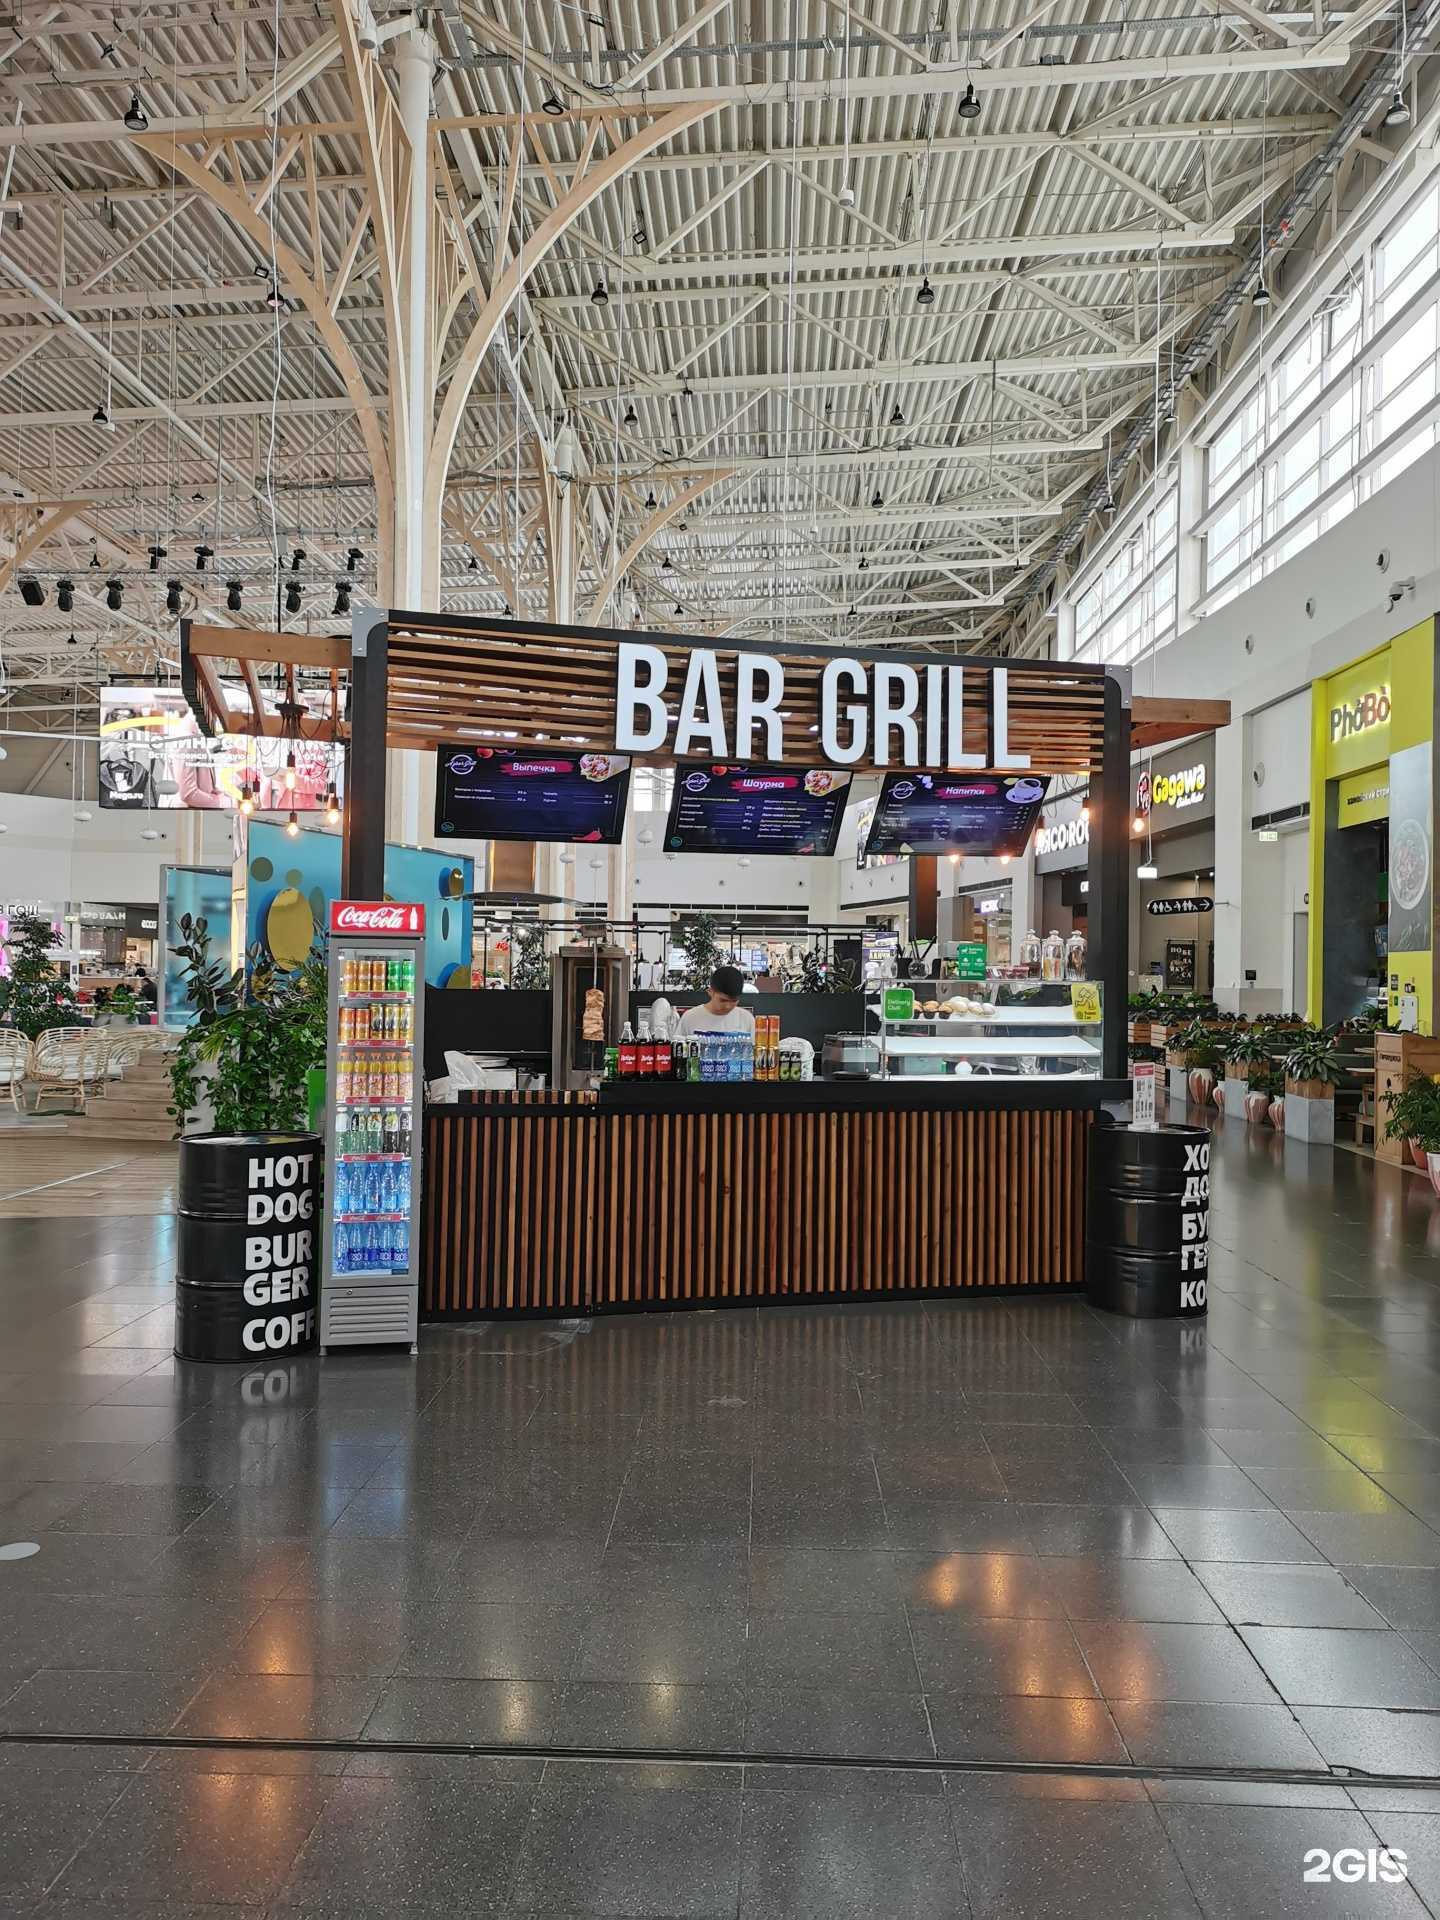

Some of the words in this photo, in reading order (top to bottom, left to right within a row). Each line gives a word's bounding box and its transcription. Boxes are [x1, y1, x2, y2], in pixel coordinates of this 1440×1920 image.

[615, 642, 785, 761] BAR
[822, 657, 1032, 769] GRILL
[512, 762, 556, 773] Выпечка
[743, 779, 785, 789] Шаурма
[945, 786, 985, 795] Напитки
[1153, 763, 1206, 806] Gagawa
[337, 906, 408, 929] Coca-Cola
[248, 1154, 314, 1189] HOT
[1182, 1143, 1211, 1172] ХО
[247, 1189, 314, 1226] DOG
[1181, 1210, 1209, 1241] БУ
[245, 1229, 313, 1271] BUR
[243, 1266, 310, 1307] GER
[1180, 1279, 1208, 1308] КО
[242, 1308, 315, 1352] COFF
